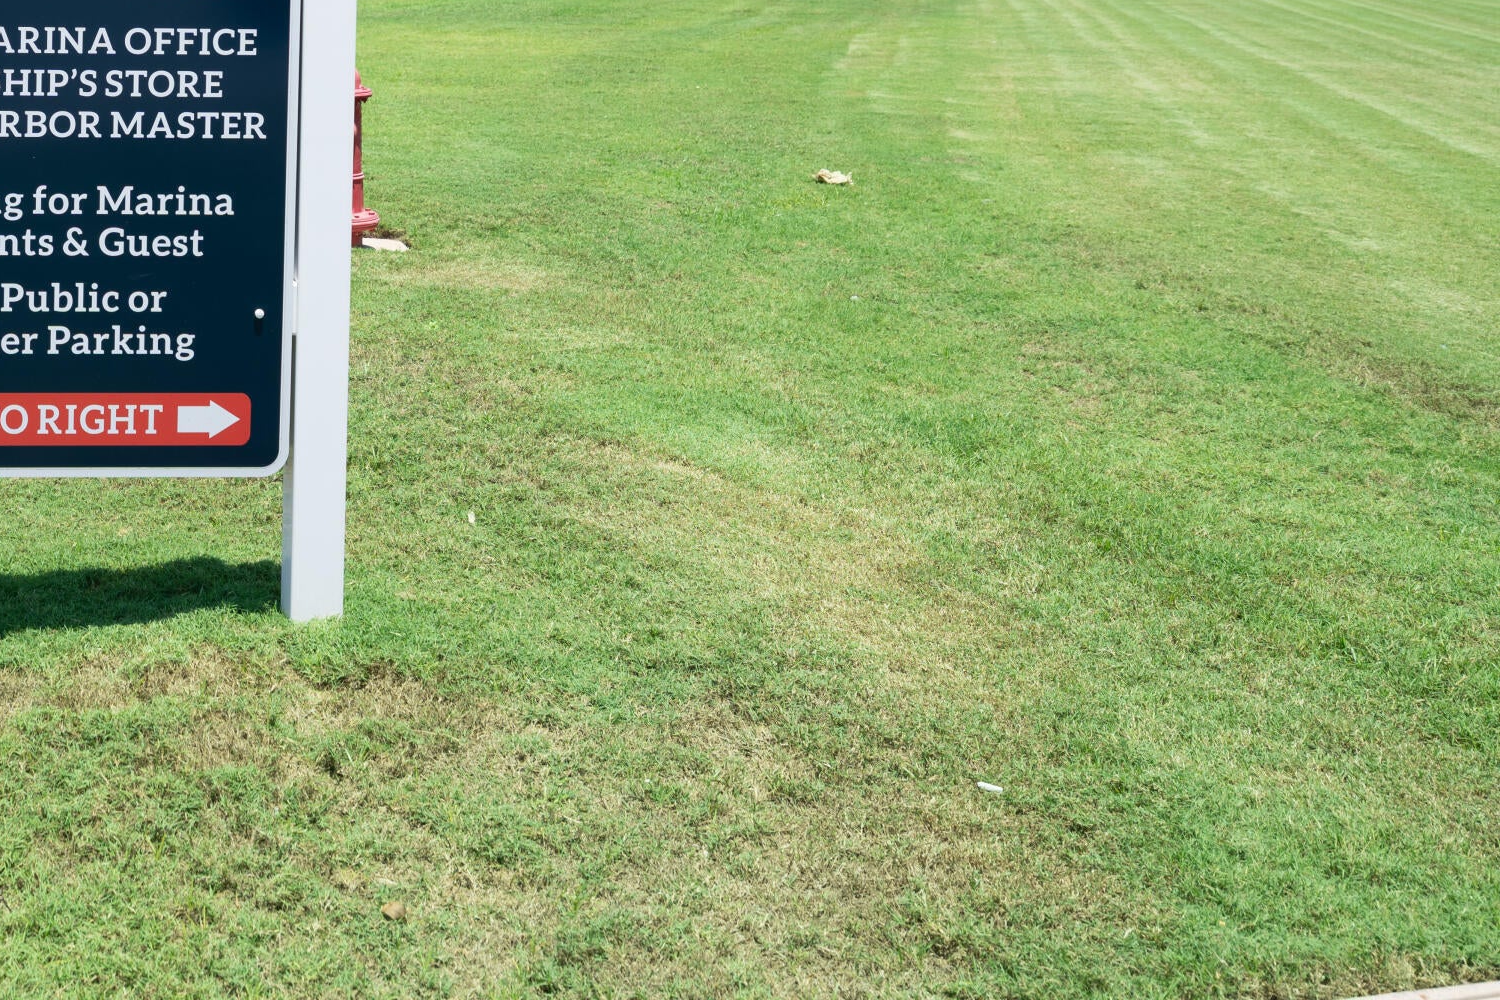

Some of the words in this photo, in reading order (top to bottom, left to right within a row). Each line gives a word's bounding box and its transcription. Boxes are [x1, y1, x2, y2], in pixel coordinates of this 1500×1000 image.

[125, 27, 258, 56] OFFICE
[105, 70, 223, 98] STORE
[111, 111, 267, 140] MASTER
[33, 185, 88, 215] for
[97, 185, 235, 216] Marina
[63, 226, 89, 257] &
[98, 227, 204, 257] Guest
[1, 282, 119, 313] Public
[129, 291, 168, 313] or
[47, 325, 196, 361] Parking
[37, 404, 164, 435] RIGHT
